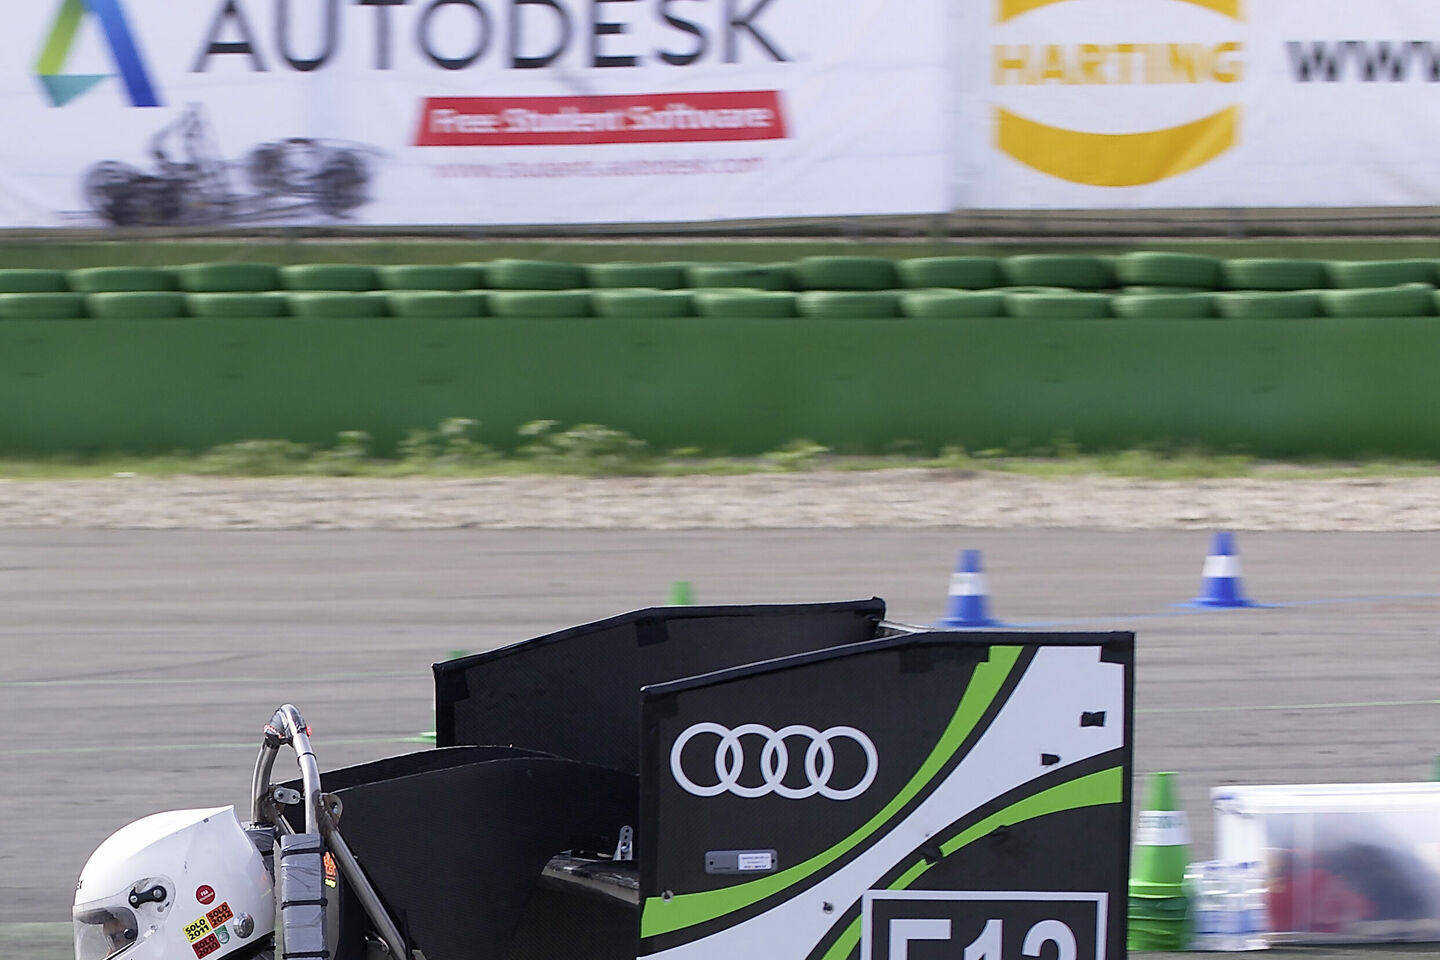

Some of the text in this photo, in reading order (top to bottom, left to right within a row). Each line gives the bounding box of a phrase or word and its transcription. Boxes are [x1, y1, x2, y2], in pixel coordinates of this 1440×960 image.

[190, 0, 790, 72] AUTODESK
[992, 42, 1244, 85] HARTING
[209, 905, 227, 919] SOLO
[213, 911, 232, 926] 2012
[185, 918, 206, 934] SOLO
[189, 924, 210, 940] 2011
